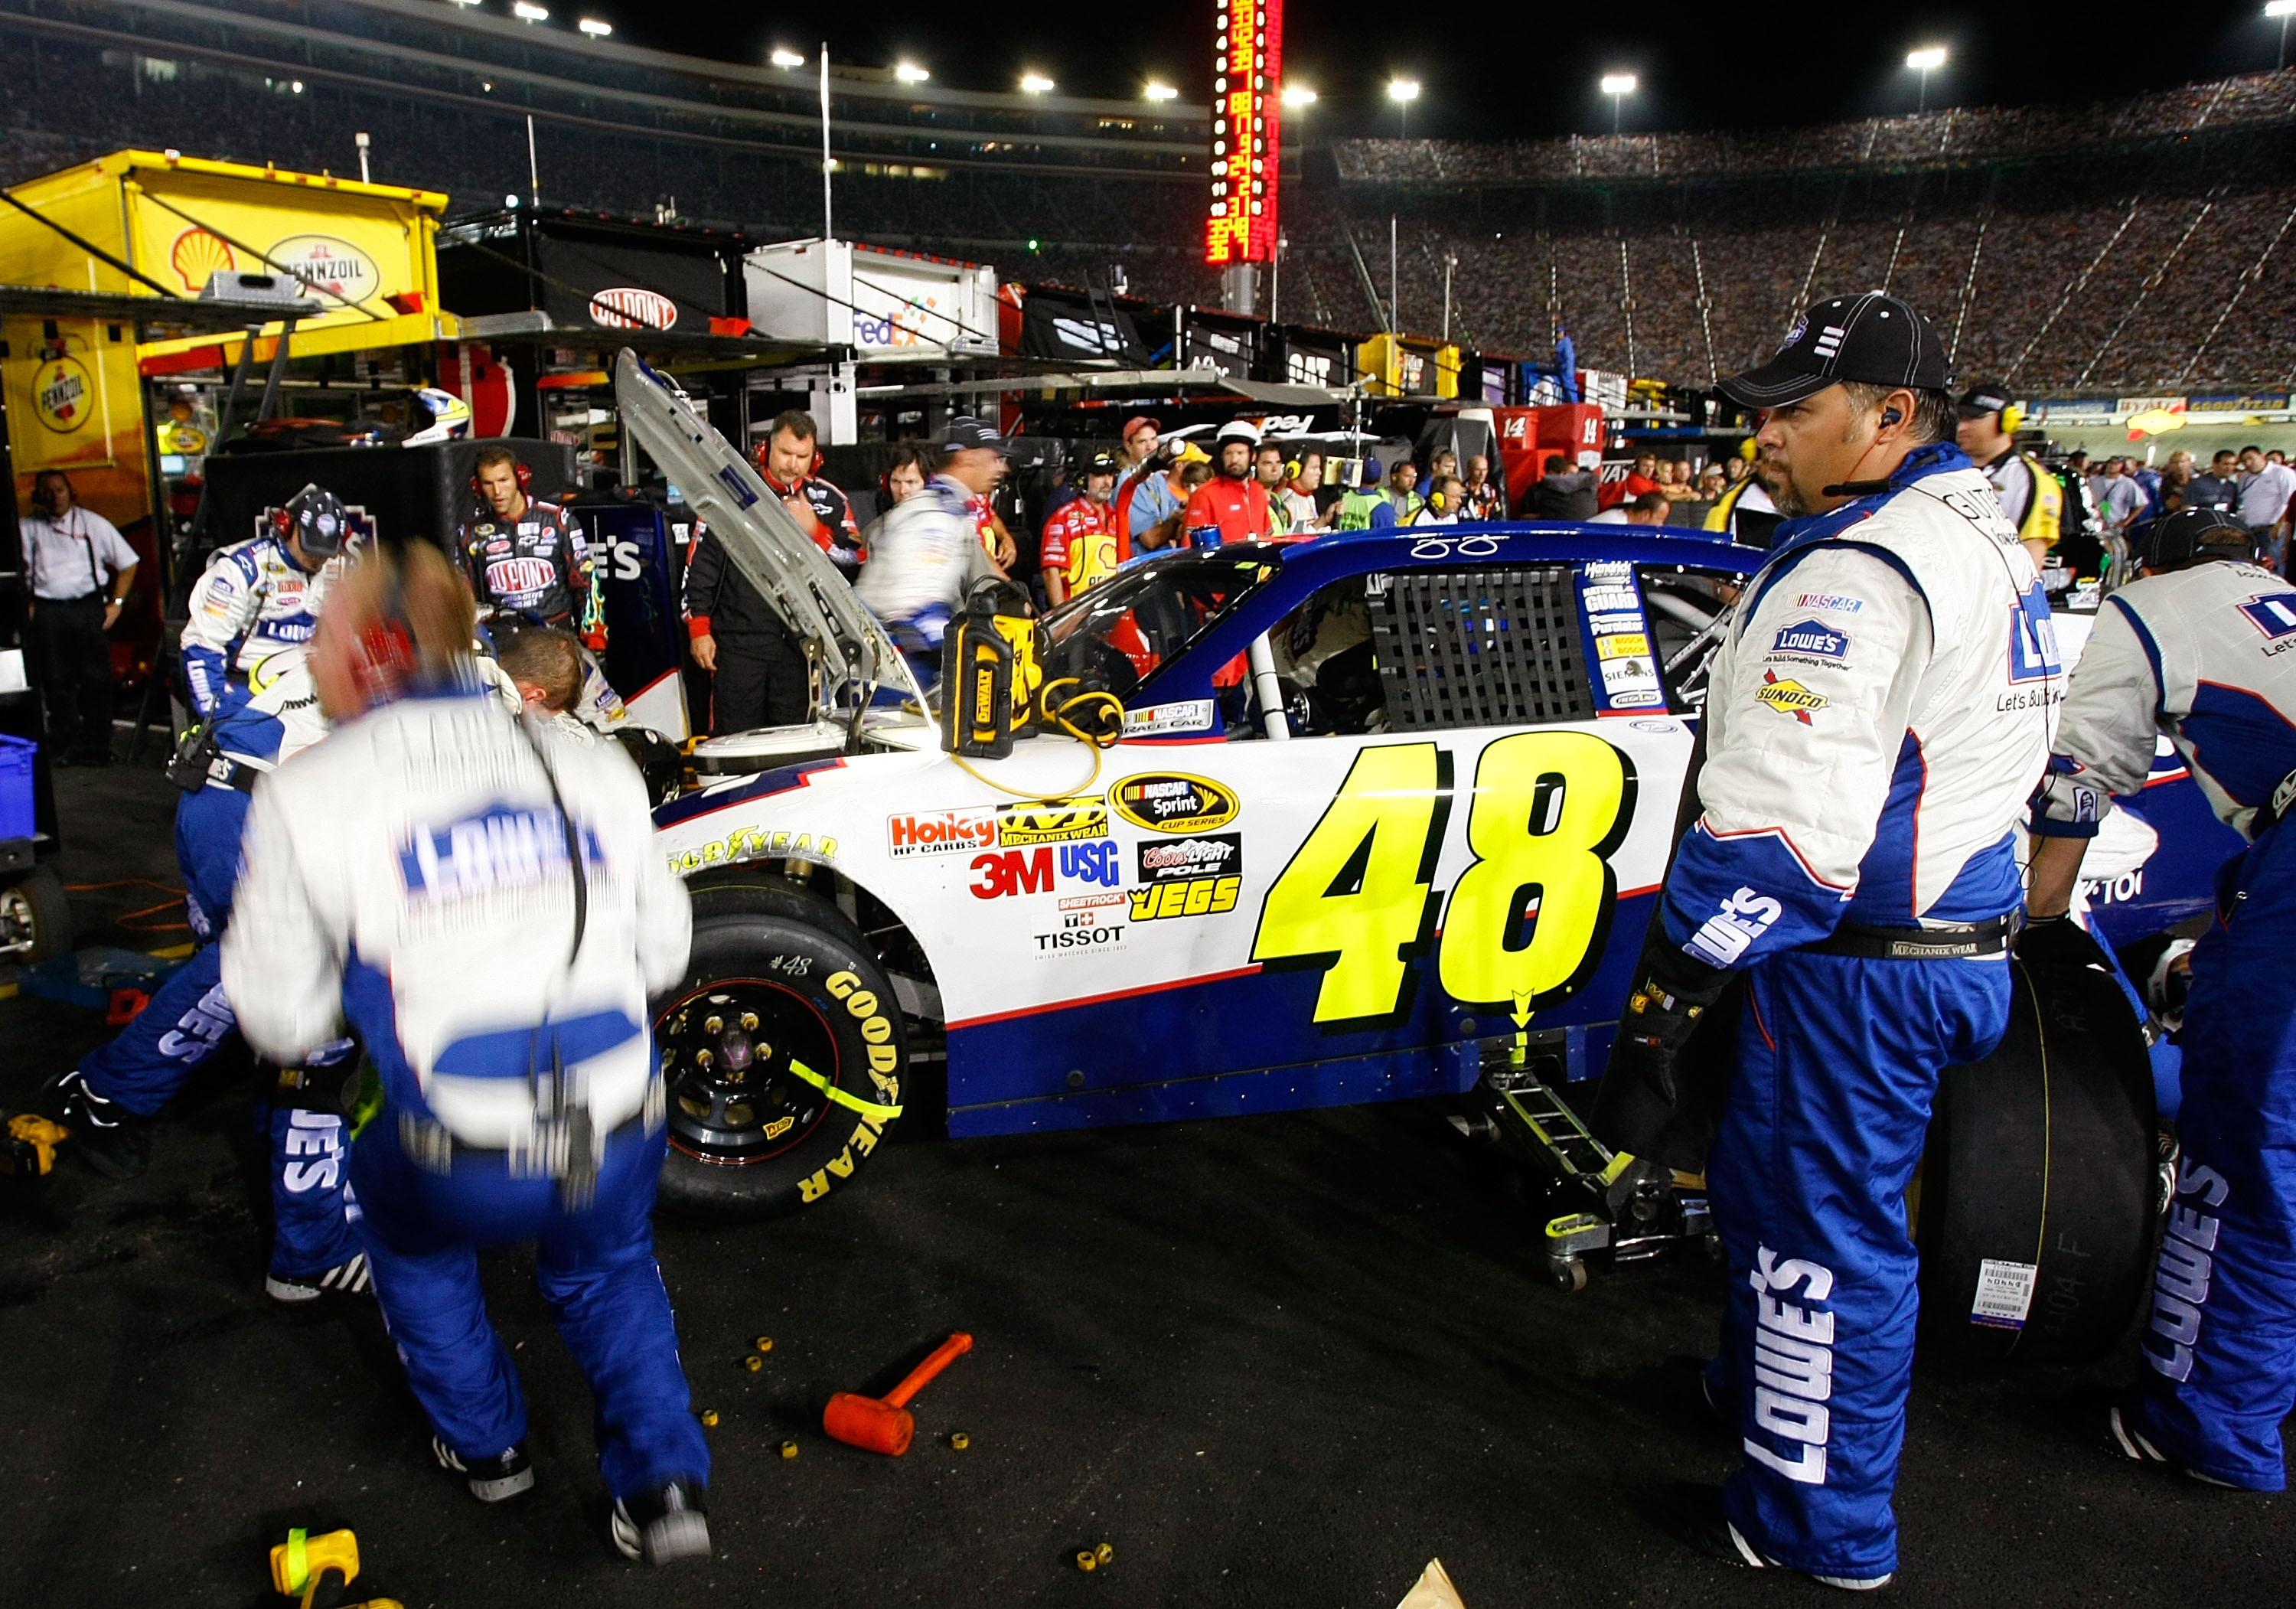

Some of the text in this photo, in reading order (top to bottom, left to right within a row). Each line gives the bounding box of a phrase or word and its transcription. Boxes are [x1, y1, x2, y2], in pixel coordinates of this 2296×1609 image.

[1231, 27, 1254, 49] 42
[1230, 91, 1252, 115] 88
[1228, 154, 1251, 177] 24
[1228, 195, 1250, 218] 31
[289, 259, 362, 285] ENNZOIL
[1503, 416, 1525, 438] 14
[1583, 417, 1598, 444] 14
[1585, 592, 1639, 613] GUARD
[1803, 594, 1859, 612] NASCAR
[1590, 621, 1644, 636] Purolator
[1615, 636, 1643, 645] BOSCH
[1779, 630, 1841, 651] LOWE'S
[1757, 688, 1824, 709] SUNOCO
[1996, 694, 2027, 712] Let's
[1153, 704, 1197, 720] NASCAR
[1143, 781, 1189, 799] NASCAR
[1153, 795, 1197, 818] Sprint
[892, 812, 995, 847] Holley
[1160, 816, 1225, 830] CUP SERIES
[1000, 823, 1108, 847] MECHANIX WEAR
[893, 840, 977, 856] HP CARBS
[1143, 845, 1234, 869] Coors LIGHT
[969, 847, 1055, 899] 3M
[1059, 840, 1120, 888] USG
[1156, 862, 1222, 878] POLE
[1251, 730, 1638, 1035] 48
[1059, 893, 1124, 909] SHEETROCK
[1129, 876, 1242, 922] JEGS
[1034, 925, 1125, 950] TISSOT
[1681, 885, 1782, 970] OWE'S
[1892, 942, 1979, 956] MECHANIX WEAR
[769, 955, 813, 976] #48
[2141, 1154, 2229, 1383] LOWES
[1744, 1242, 1835, 1485] LOWE'S
